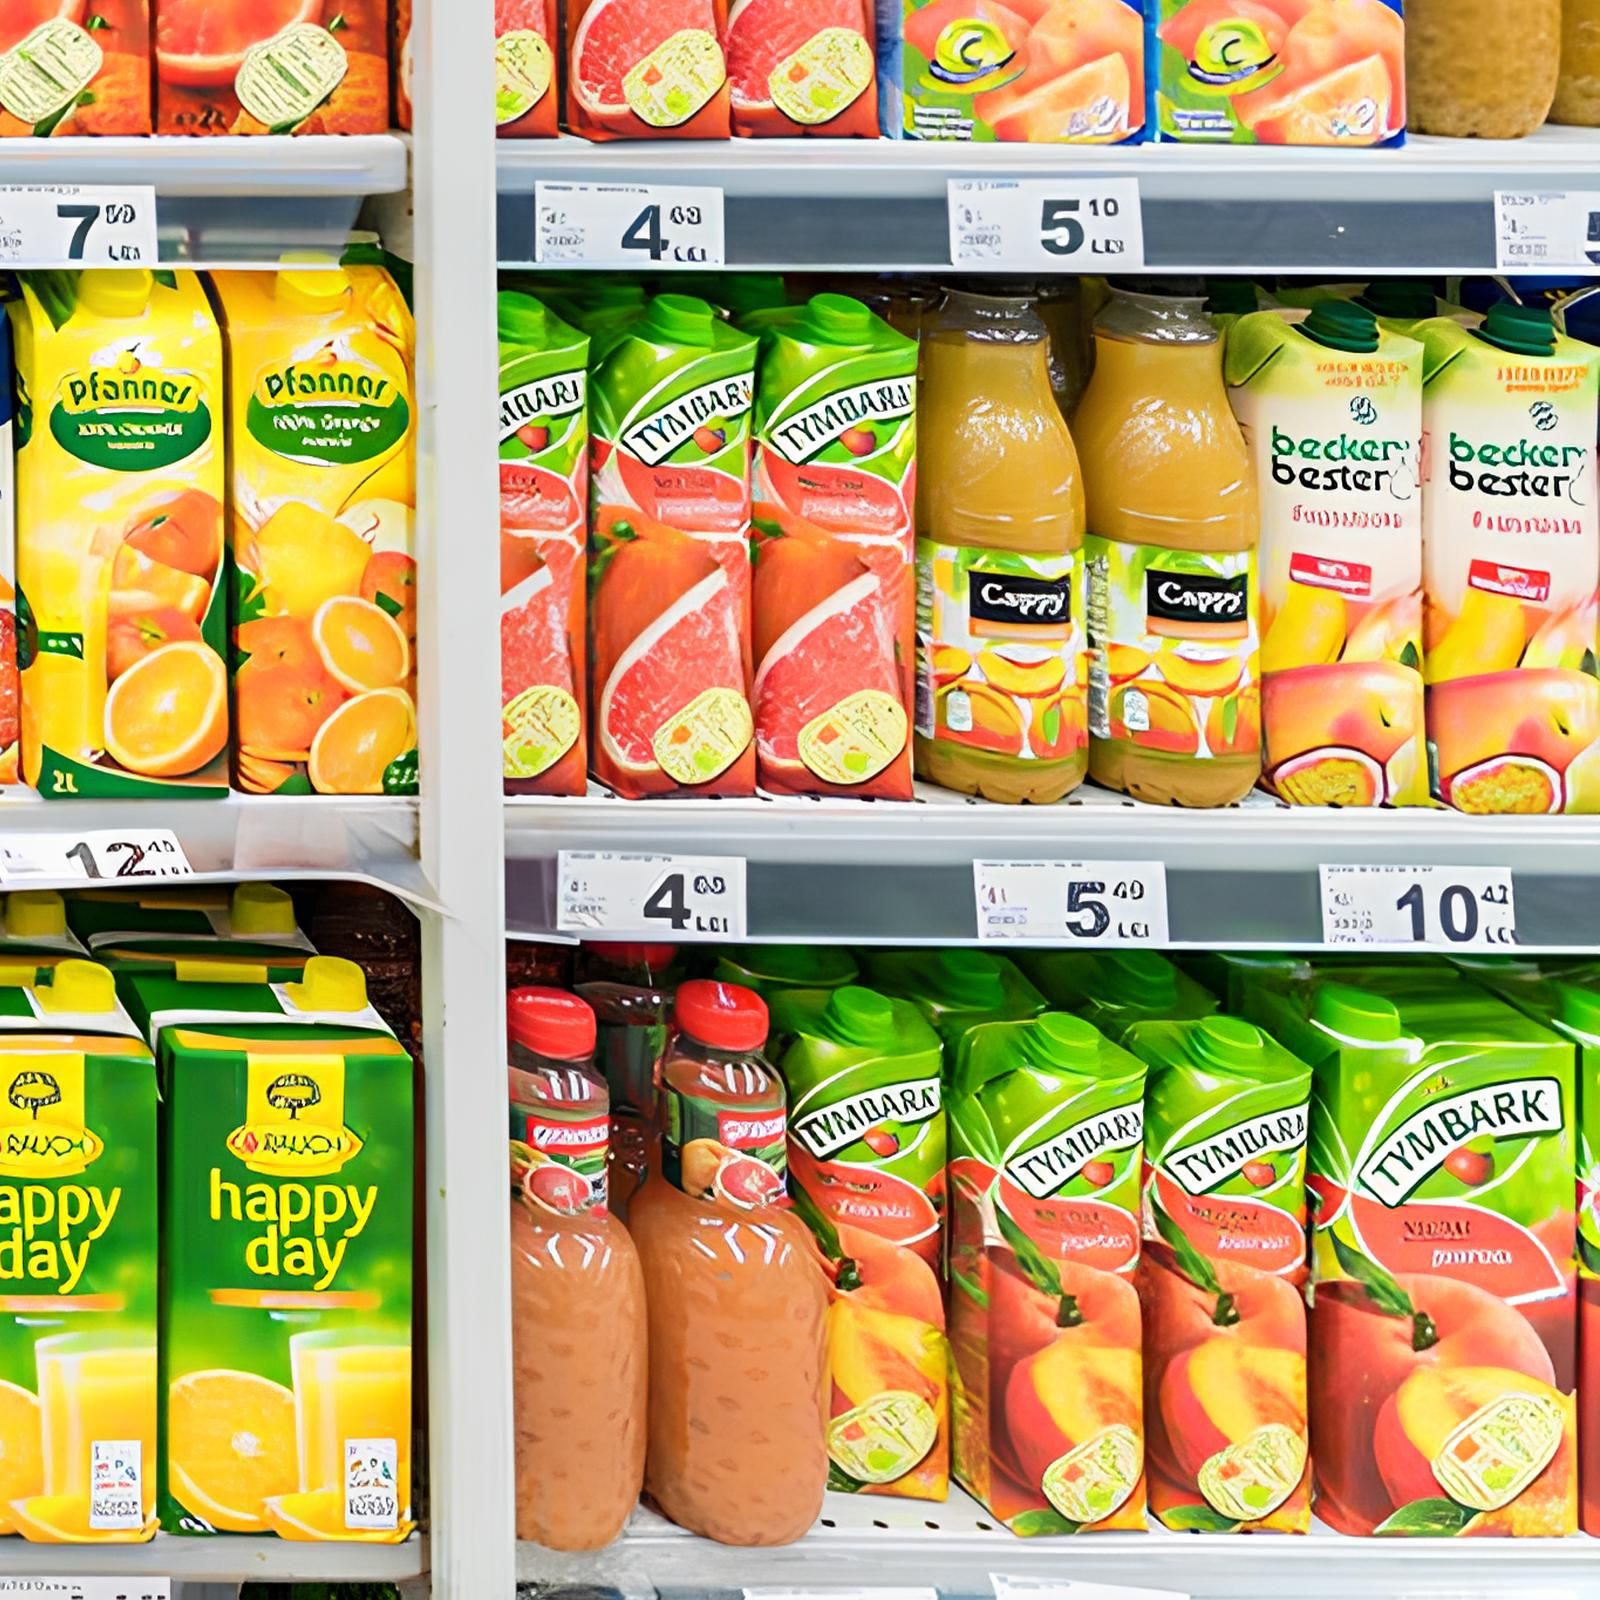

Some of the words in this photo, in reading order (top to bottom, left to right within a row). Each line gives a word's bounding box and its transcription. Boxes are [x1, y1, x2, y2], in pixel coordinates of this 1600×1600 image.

[56, 205, 100, 259] 7
[620, 205, 668, 260] 4
[1041, 199, 1084, 253] 5
[643, 874, 691, 929] 4
[1067, 881, 1110, 938] 5
[1396, 884, 1478, 943] 10
[1372, 1089, 1548, 1190] TYMBARK
[209, 1168, 378, 1238] happy
[246, 1230, 347, 1291] day
